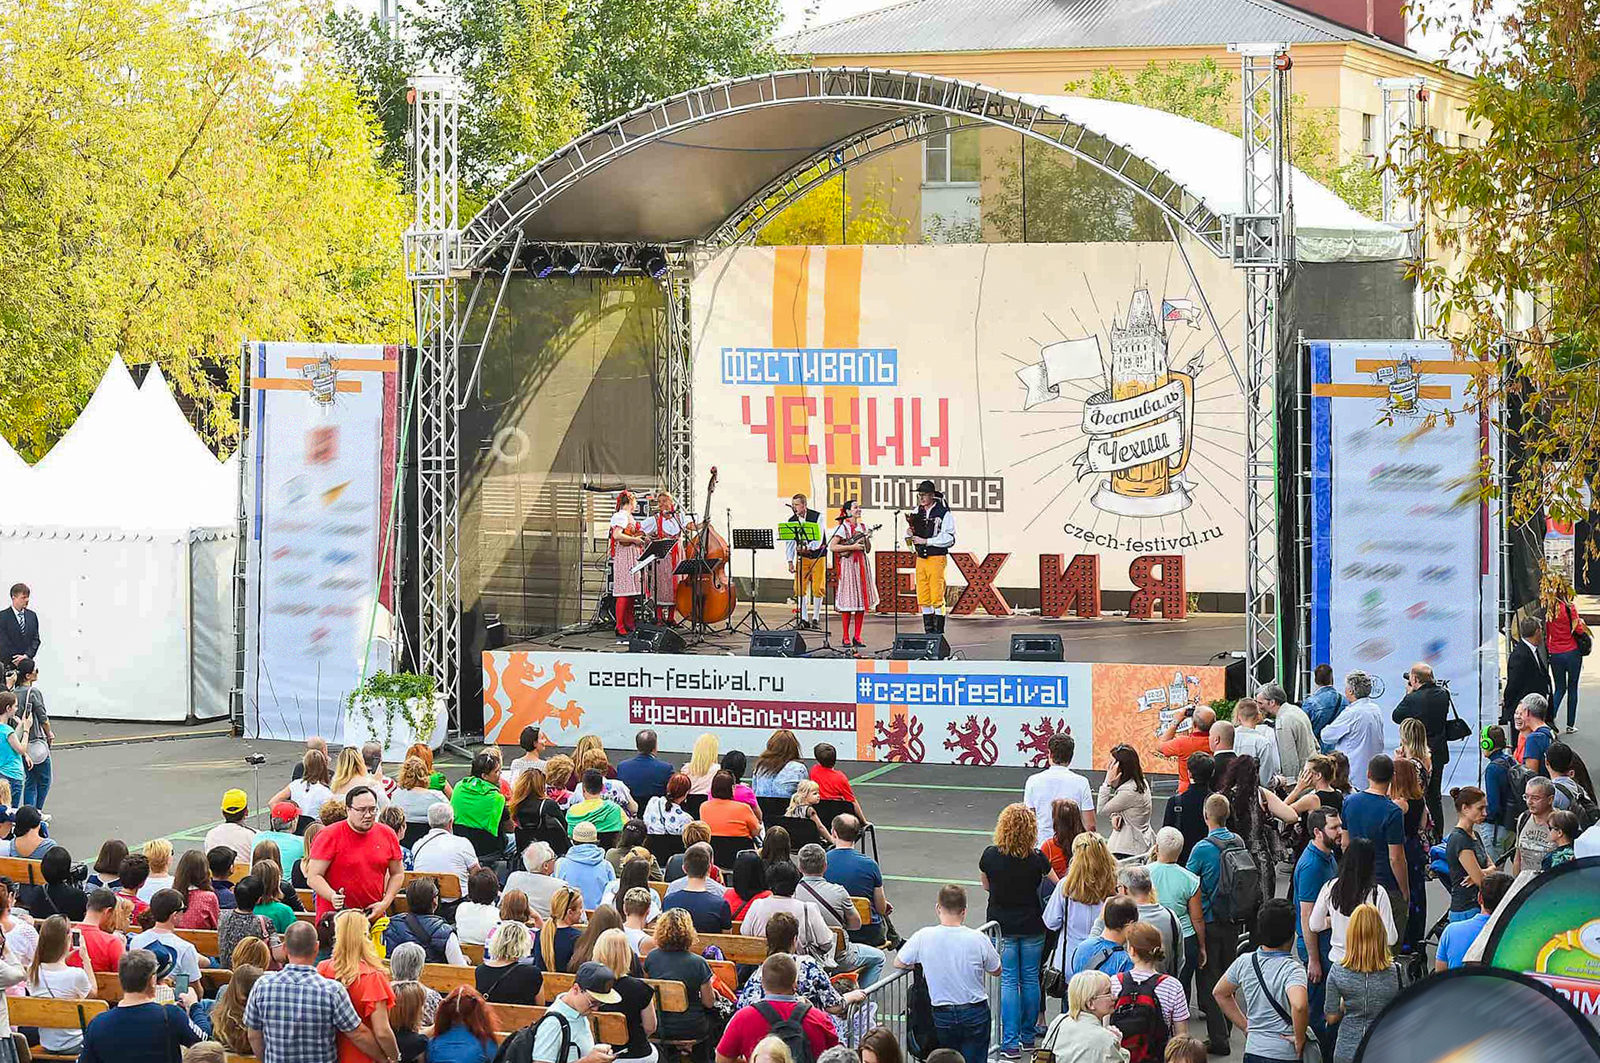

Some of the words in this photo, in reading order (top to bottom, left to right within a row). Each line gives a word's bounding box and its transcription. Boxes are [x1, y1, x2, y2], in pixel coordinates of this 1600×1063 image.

[724, 348, 894, 384] ФЕСТИВАЛЬ
[1090, 391, 1180, 426] Фестиваль
[741, 396, 949, 466] ЧЕХИИ
[1098, 433, 1171, 464] Чехии
[829, 477, 862, 507] НА
[871, 475, 1001, 510] ФЛОНЕ
[1063, 525, 1224, 552] czech-festival.ru
[827, 551, 1187, 620] ЕХИЯ
[589, 667, 785, 692] czech-festival.ru
[859, 677, 1066, 705] #czechfestival
[631, 700, 855, 729] #фестивальчехии
